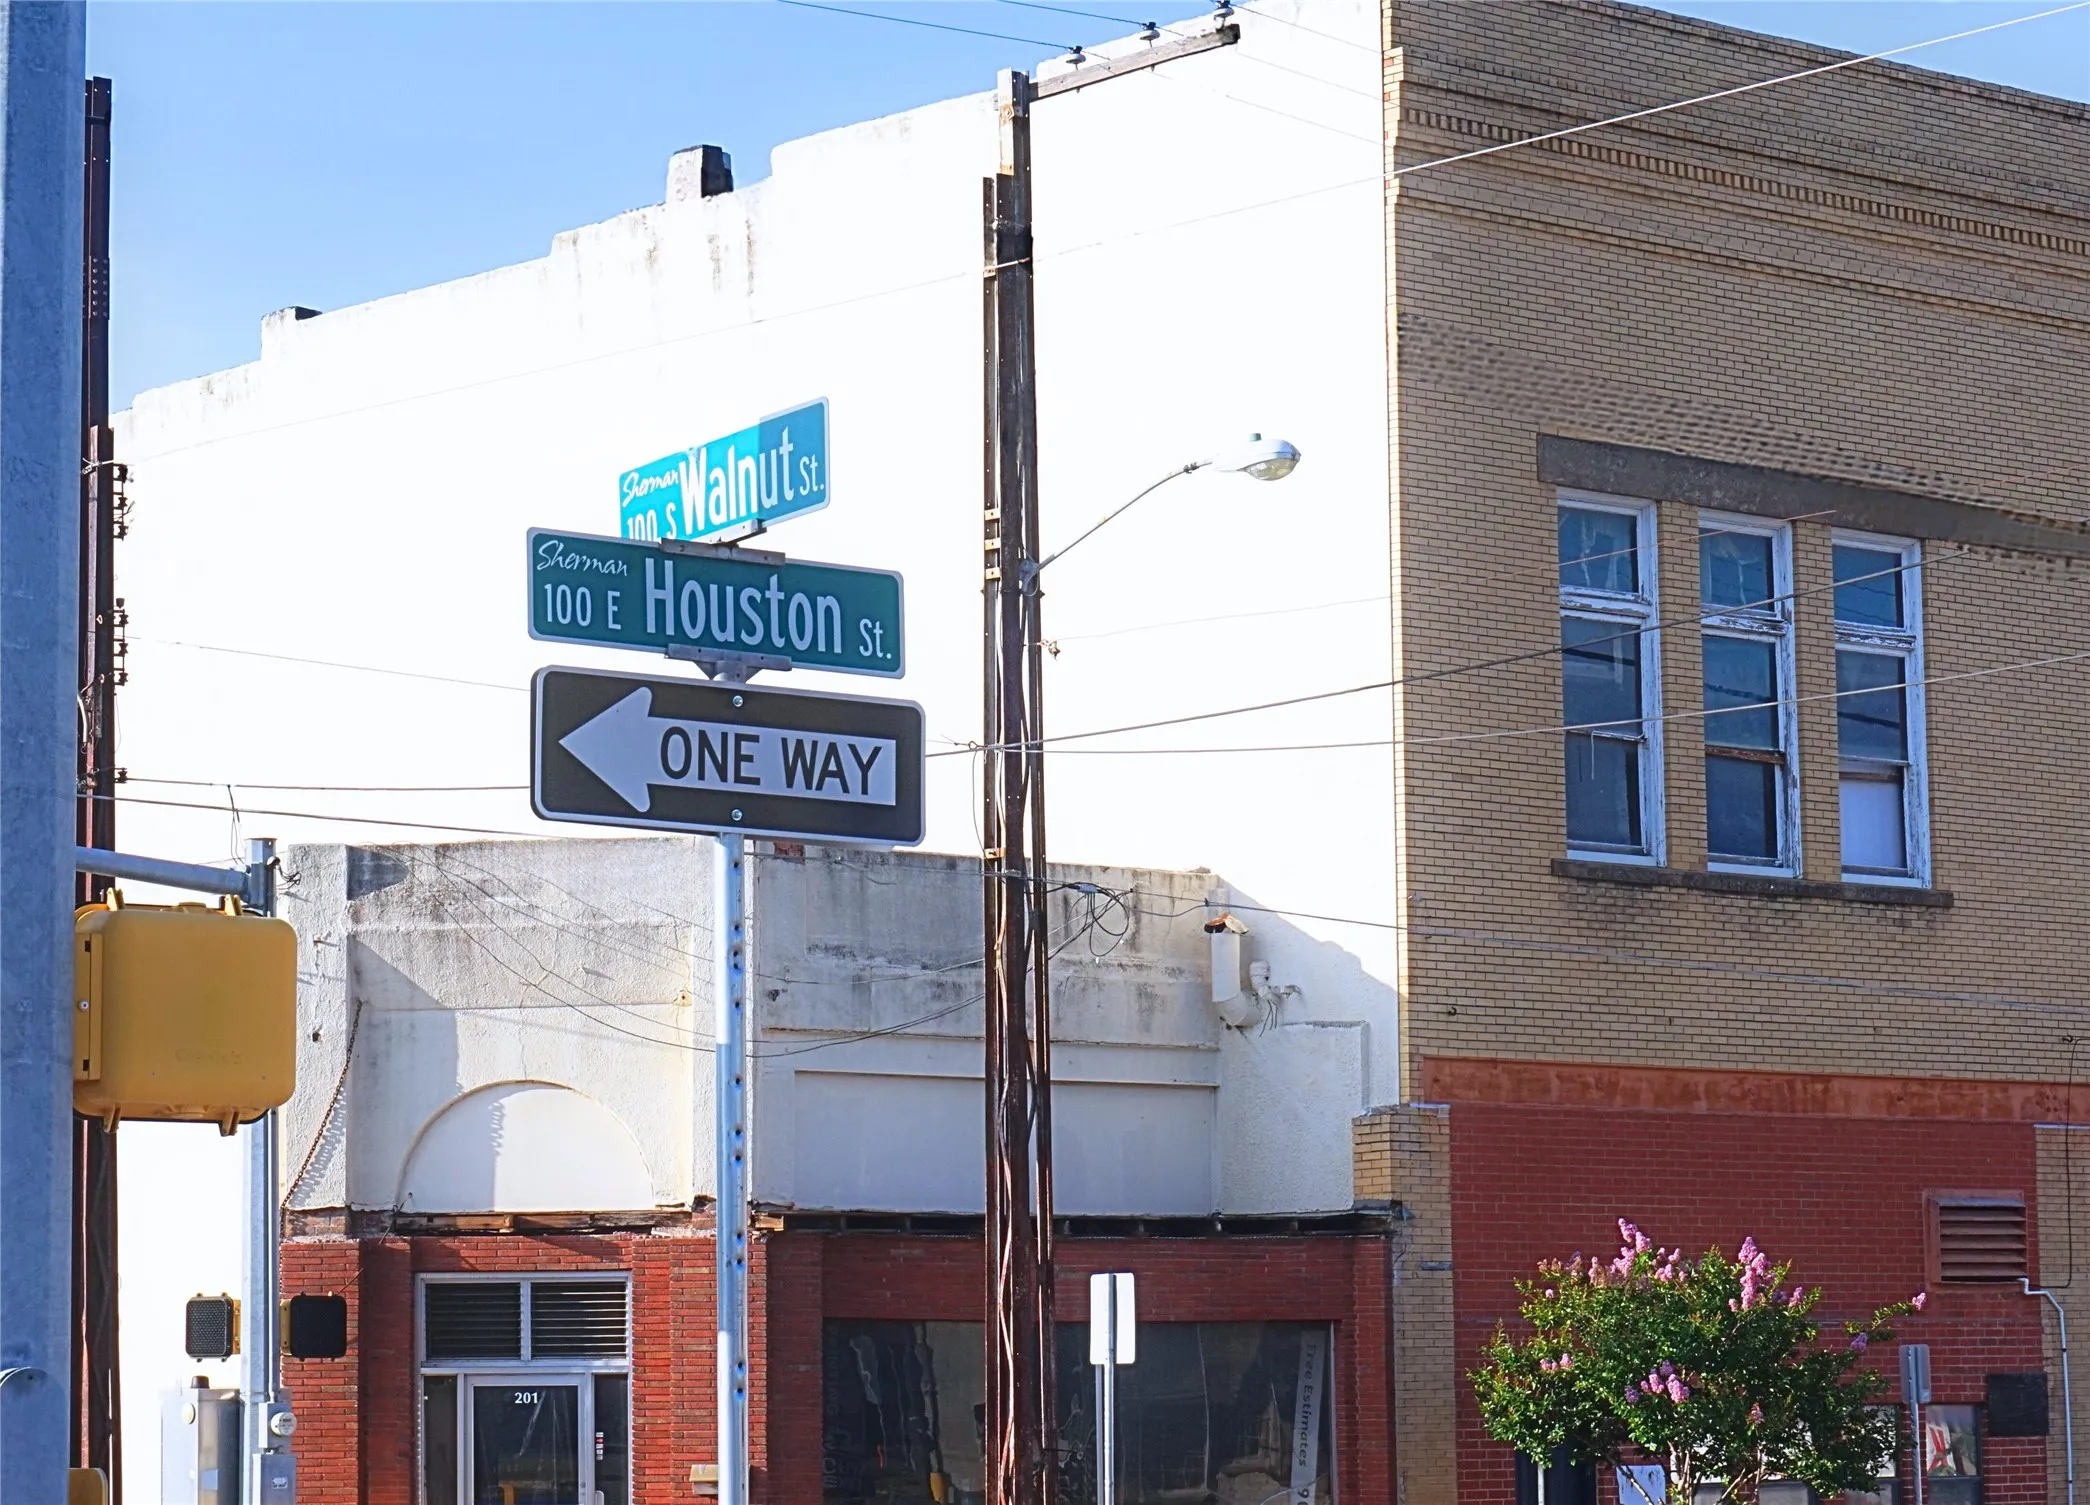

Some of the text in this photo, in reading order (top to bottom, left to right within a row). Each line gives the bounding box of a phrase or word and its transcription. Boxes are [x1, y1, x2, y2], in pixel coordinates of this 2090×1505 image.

[665, 502, 677, 540] S
[678, 427, 795, 535] Walnut
[799, 454, 825, 497] St.
[536, 539, 628, 576] Sherman
[544, 557, 892, 660] 100 E Houston St.
[660, 726, 882, 796] ONE WAY
[514, 1391, 539, 1404] 201
[1298, 1343, 1317, 1467] Free Estimates
